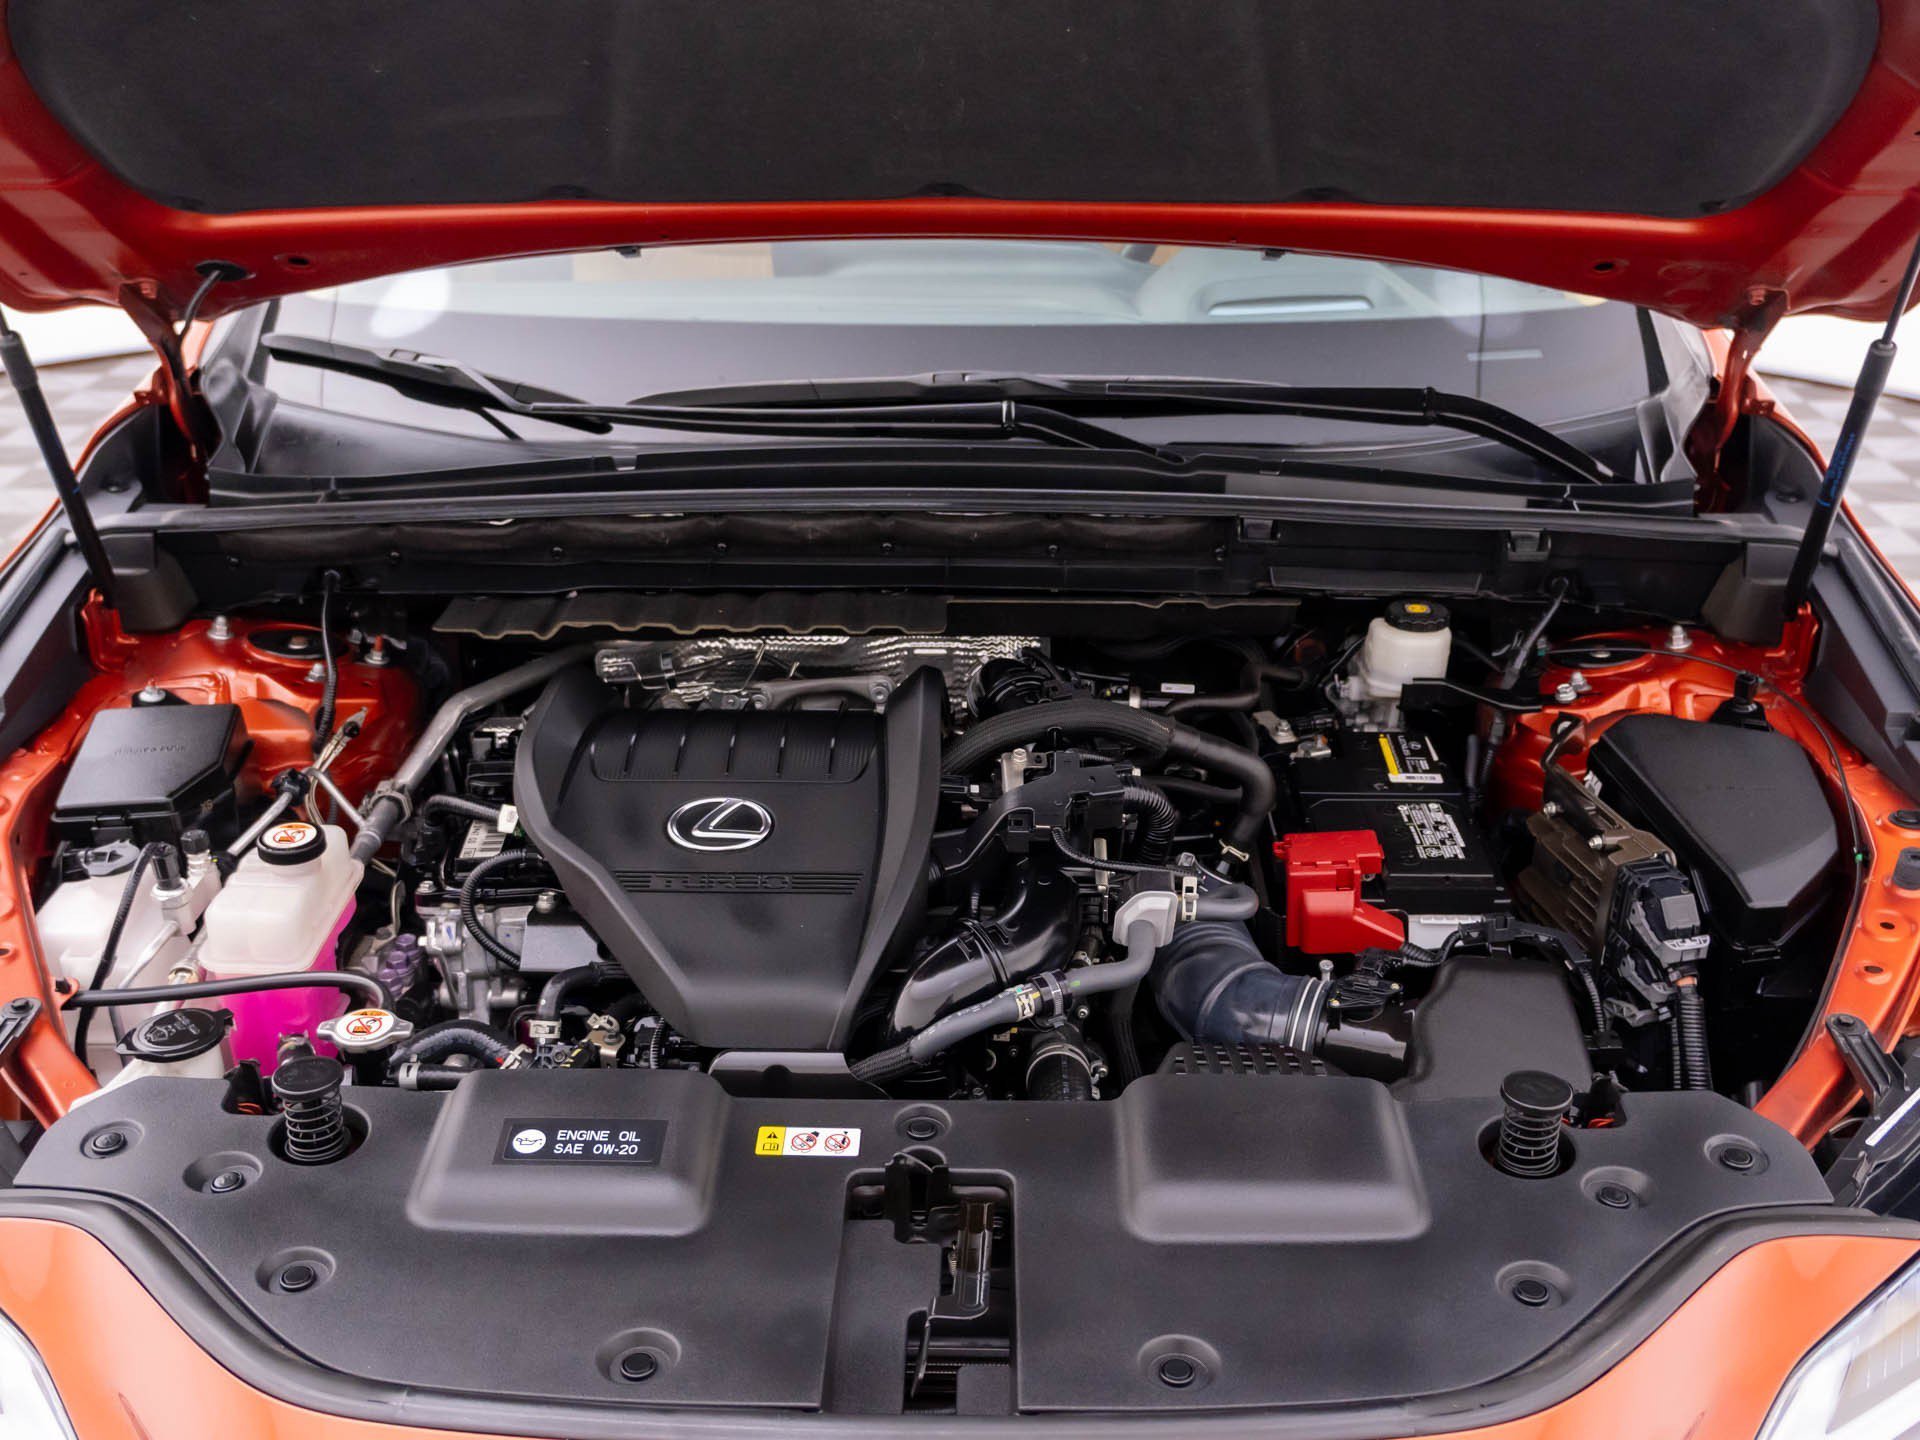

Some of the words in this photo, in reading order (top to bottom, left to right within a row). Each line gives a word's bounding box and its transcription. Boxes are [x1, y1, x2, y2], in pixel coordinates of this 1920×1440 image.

[556, 1129, 610, 1141] ENGINE
[618, 1130, 641, 1142] OIL
[553, 1143, 584, 1154] SAE
[592, 1144, 638, 1155] 0W-20
